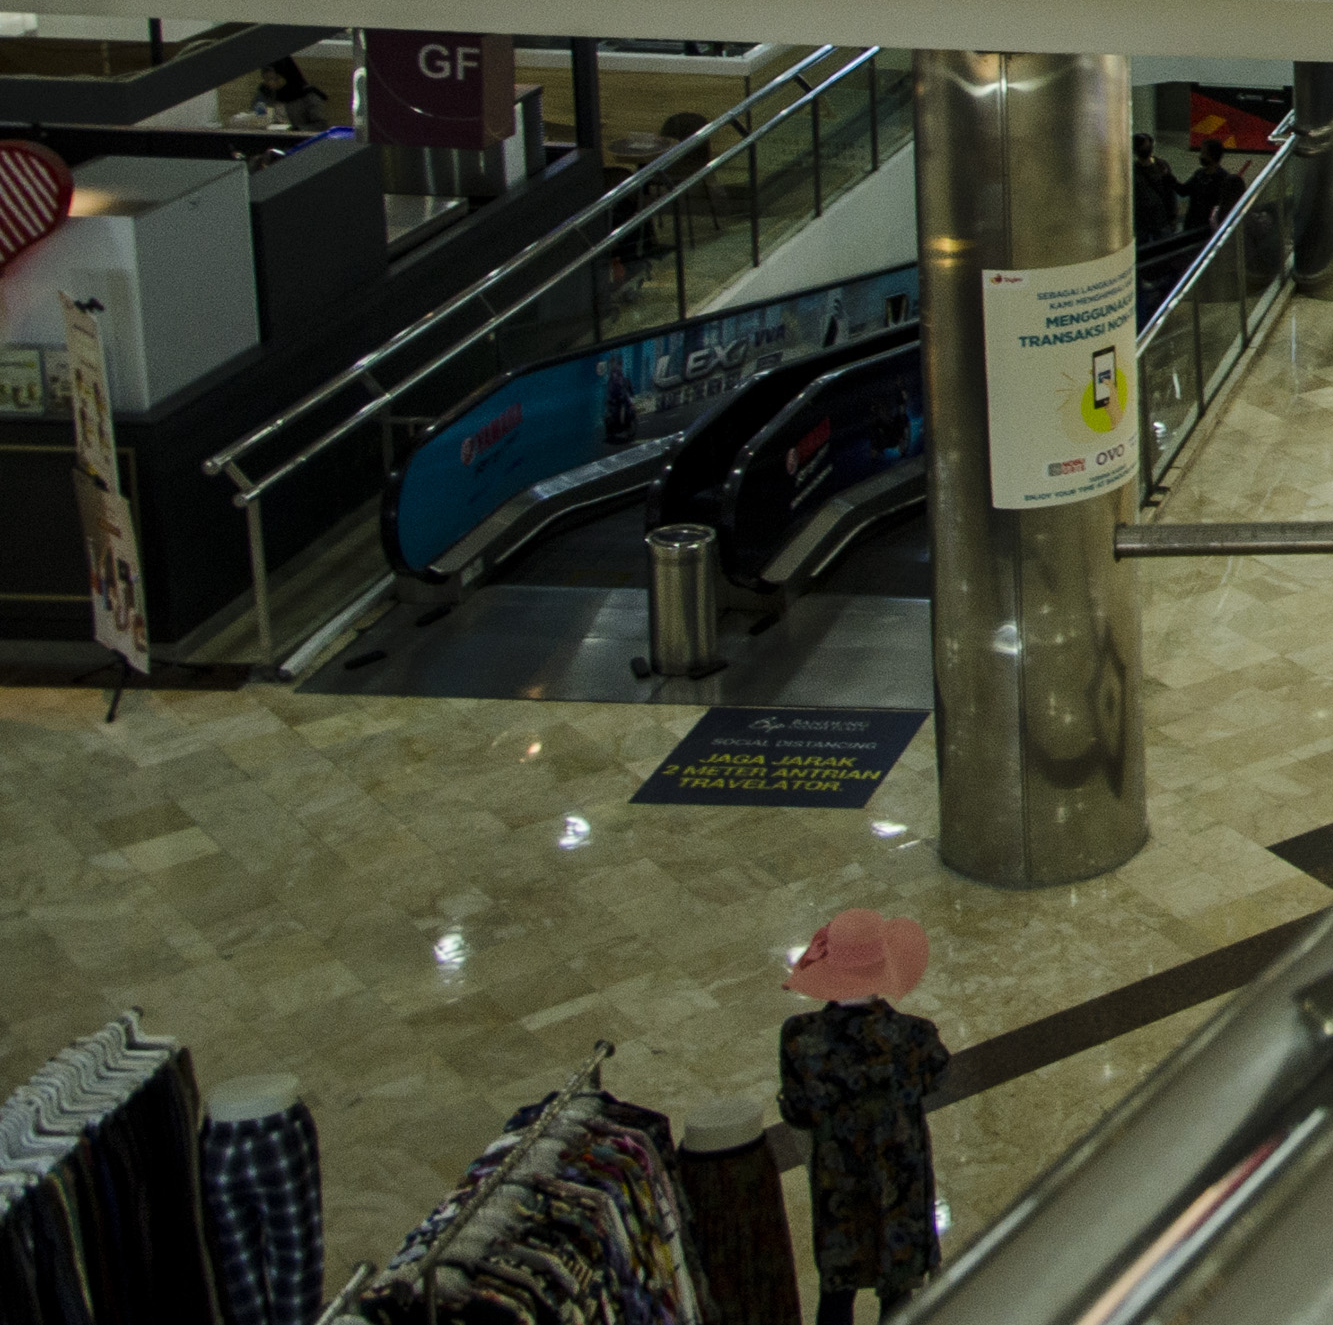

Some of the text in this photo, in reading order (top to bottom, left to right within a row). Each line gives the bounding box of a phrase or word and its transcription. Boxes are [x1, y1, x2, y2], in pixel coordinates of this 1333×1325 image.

[417, 43, 482, 81] GF
[1019, 324, 1107, 349] TRANSAKSI
[1096, 443, 1126, 466] OVO
[711, 738, 878, 750] SOCIAL DISTANCING
[699, 753, 857, 767] JAGA JARAK
[662, 765, 882, 780] 2 METER ANTRIAN
